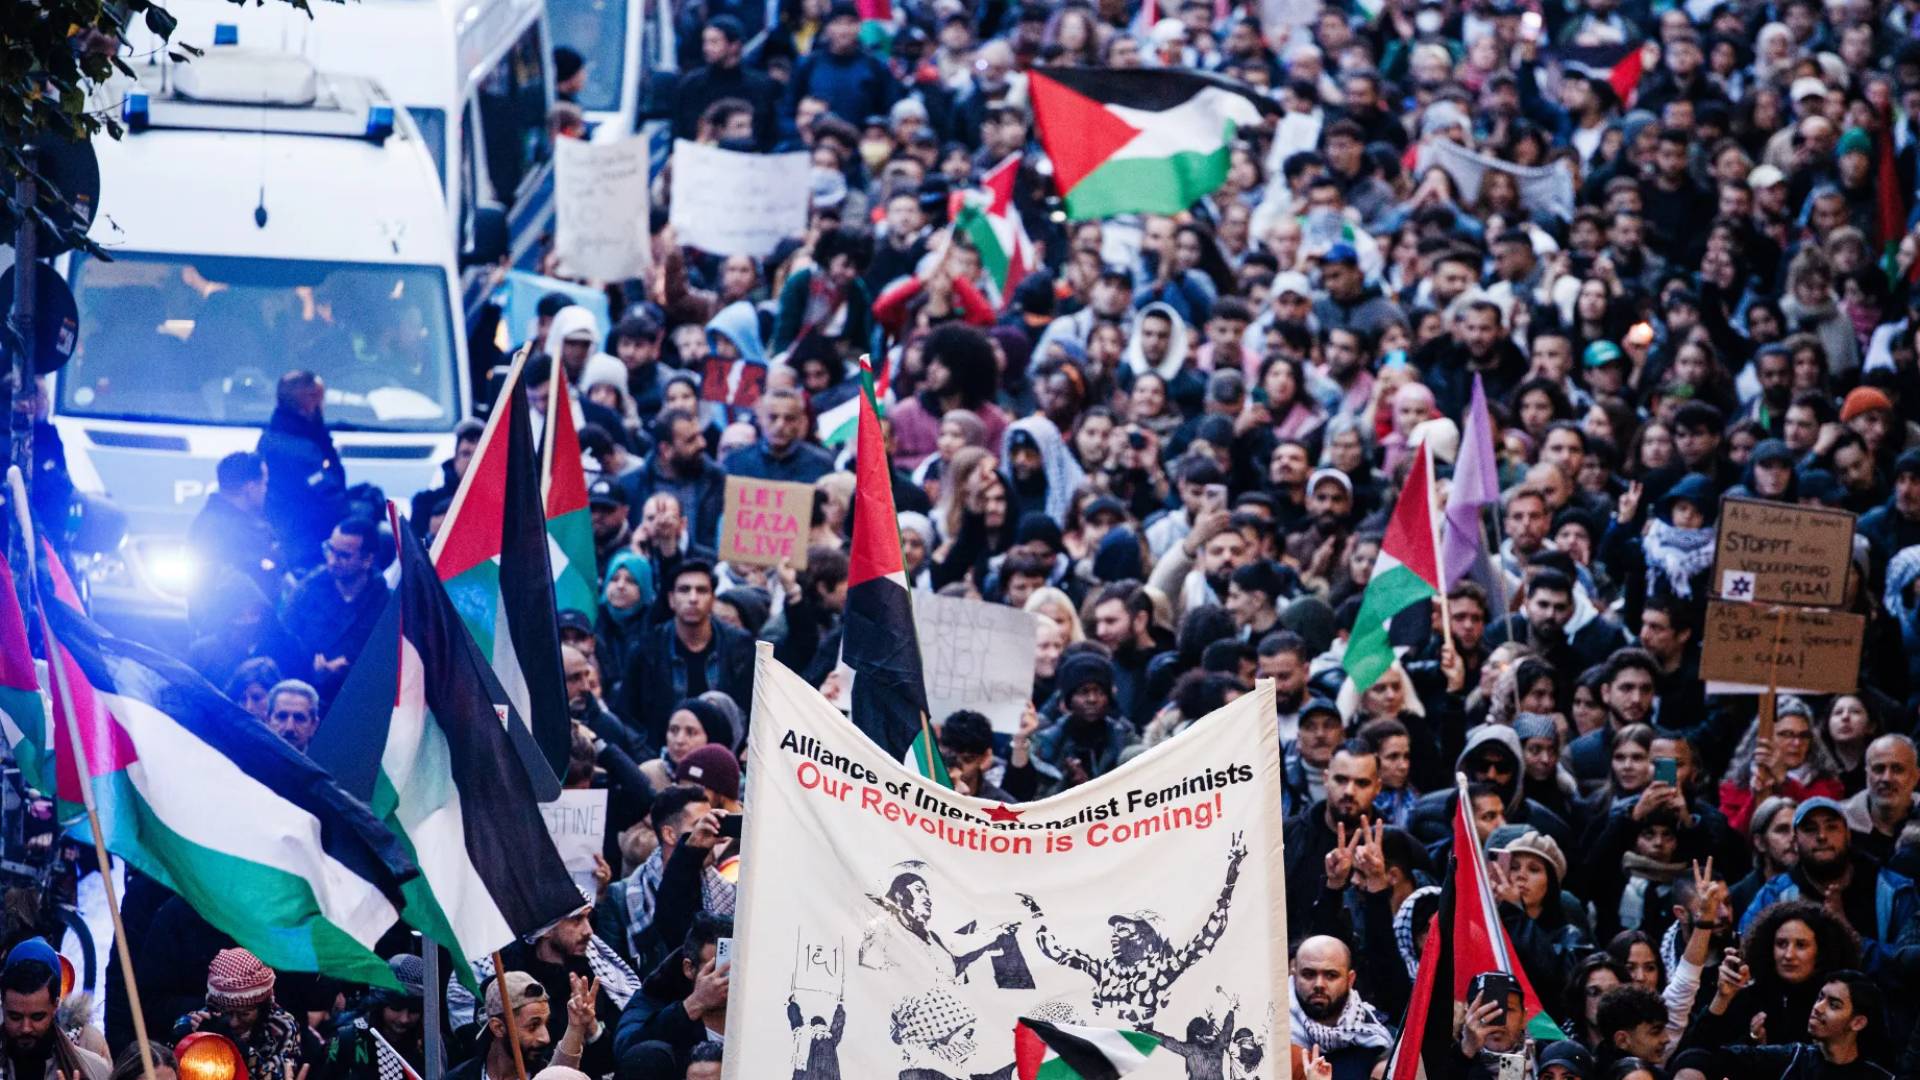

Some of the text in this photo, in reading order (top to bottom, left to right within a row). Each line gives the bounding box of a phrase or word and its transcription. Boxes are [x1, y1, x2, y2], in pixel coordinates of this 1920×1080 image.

[738, 486, 785, 508] LET
[736, 510, 799, 534] GAZA
[733, 533, 796, 558] LIVE
[1725, 531, 1792, 554] STOPPT
[779, 729, 1253, 831] Alliance of Internationalist Feminists
[797, 761, 1222, 854] Our Revolution is Coming!
[541, 804, 604, 837] STINE
